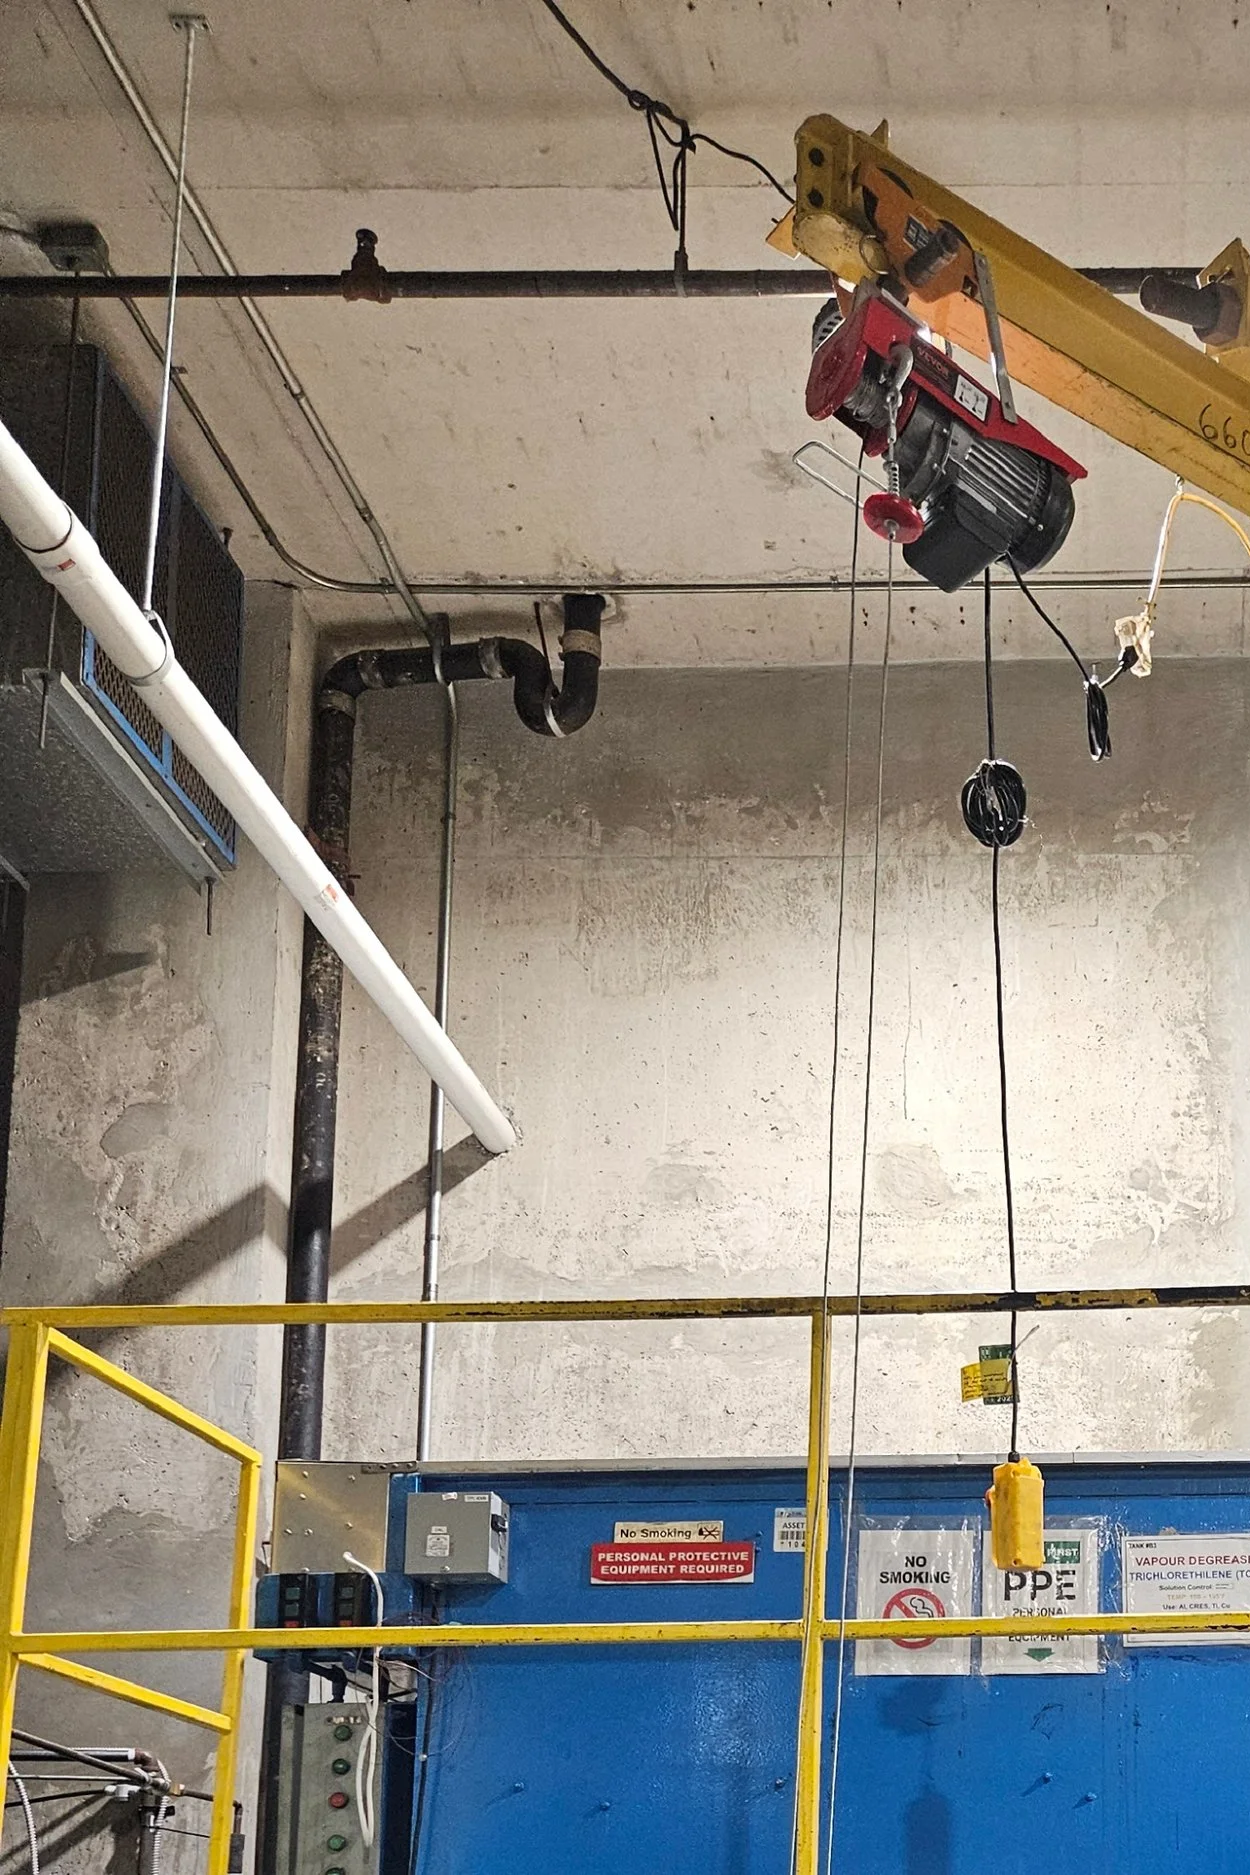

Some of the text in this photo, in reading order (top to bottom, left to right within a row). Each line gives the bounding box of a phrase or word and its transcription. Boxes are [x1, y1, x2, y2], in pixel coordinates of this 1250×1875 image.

[620, 1528, 692, 1540] No Smoking
[598, 1551, 749, 1562] PERSONAL PROTECTIVE
[905, 1556, 927, 1567] NO
[1135, 1556, 1185, 1566] VAPOUR
[601, 1564, 744, 1575] EQUIPMENT REQUIRED
[879, 1571, 951, 1584] SMOKING
[1129, 1570, 1232, 1581] TRICHLORETHILENE
[1004, 1570, 1076, 1600] PPE
